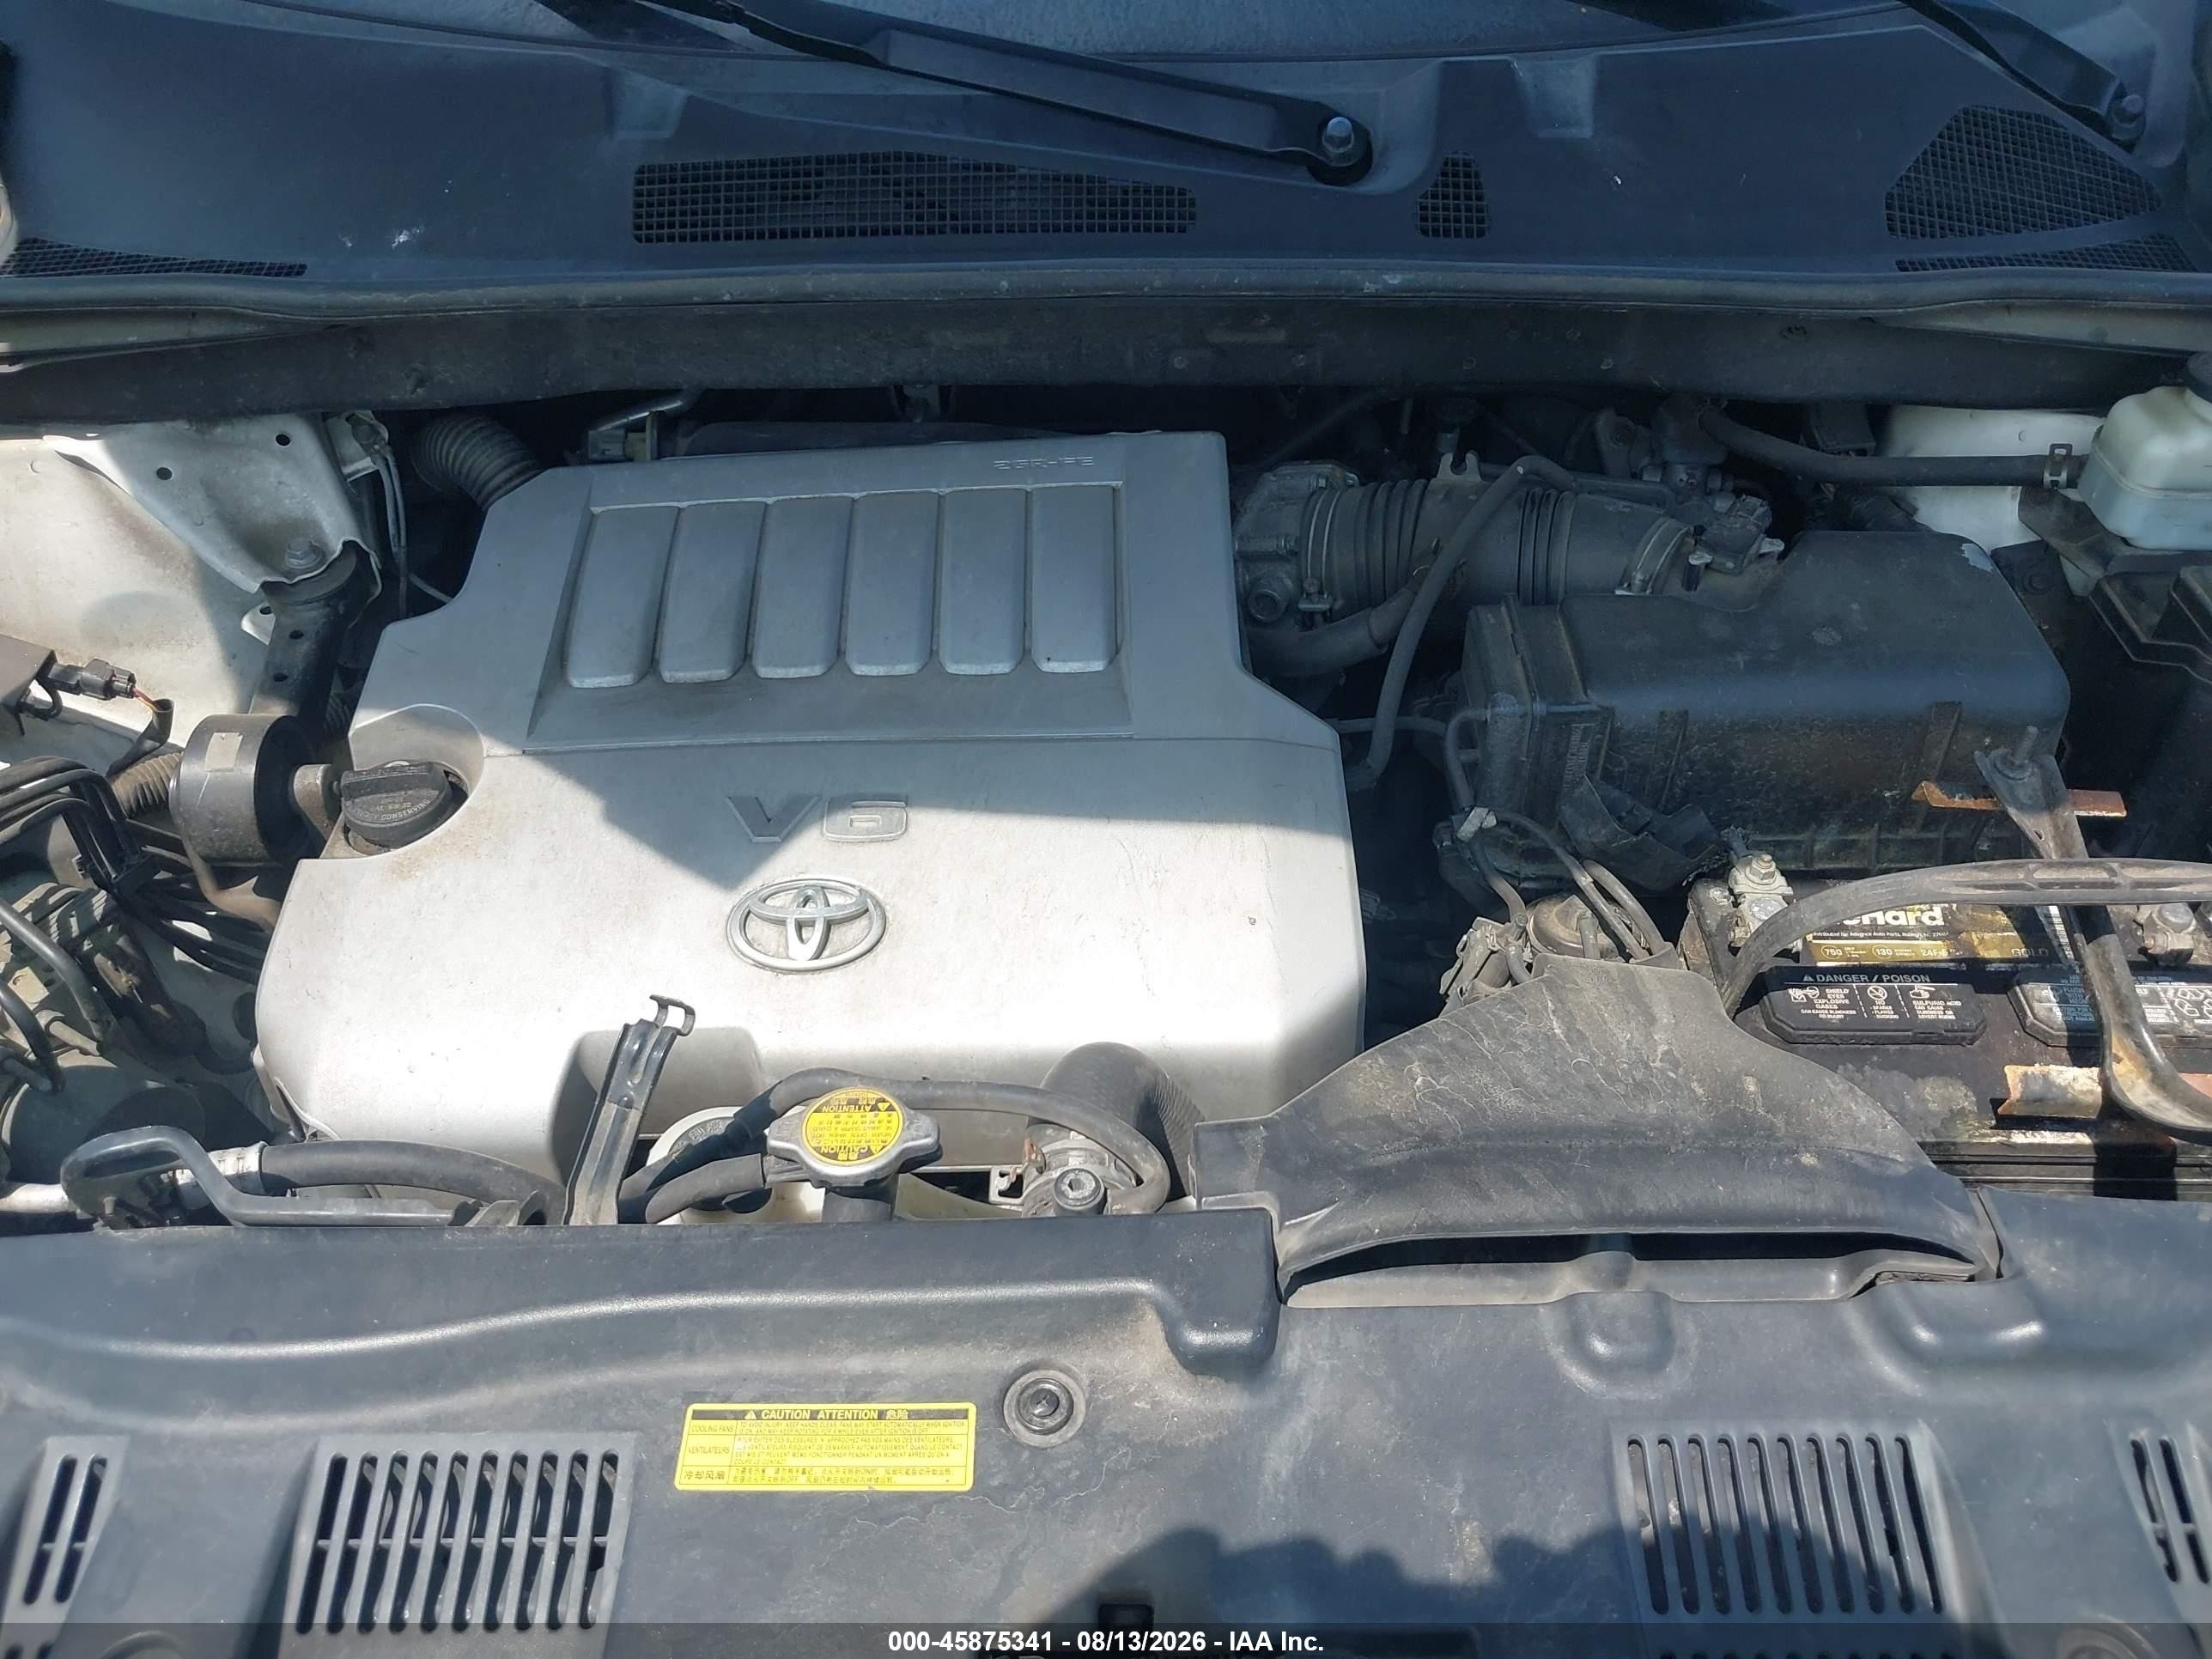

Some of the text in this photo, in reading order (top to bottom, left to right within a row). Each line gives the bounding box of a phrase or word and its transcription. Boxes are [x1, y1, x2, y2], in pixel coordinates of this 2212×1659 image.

[2012, 948, 2048, 957] GOLD
[1816, 975, 1869, 983] DANGER
[1881, 975, 1930, 983] POISON
[823, 1104, 872, 1113] ATTENTION
[820, 1145, 868, 1154] CAUTION
[761, 1409, 811, 1420] CAUTION
[817, 1409, 878, 1420] ATTENTION
[688, 1446, 730, 1455] VENTILATEURS
